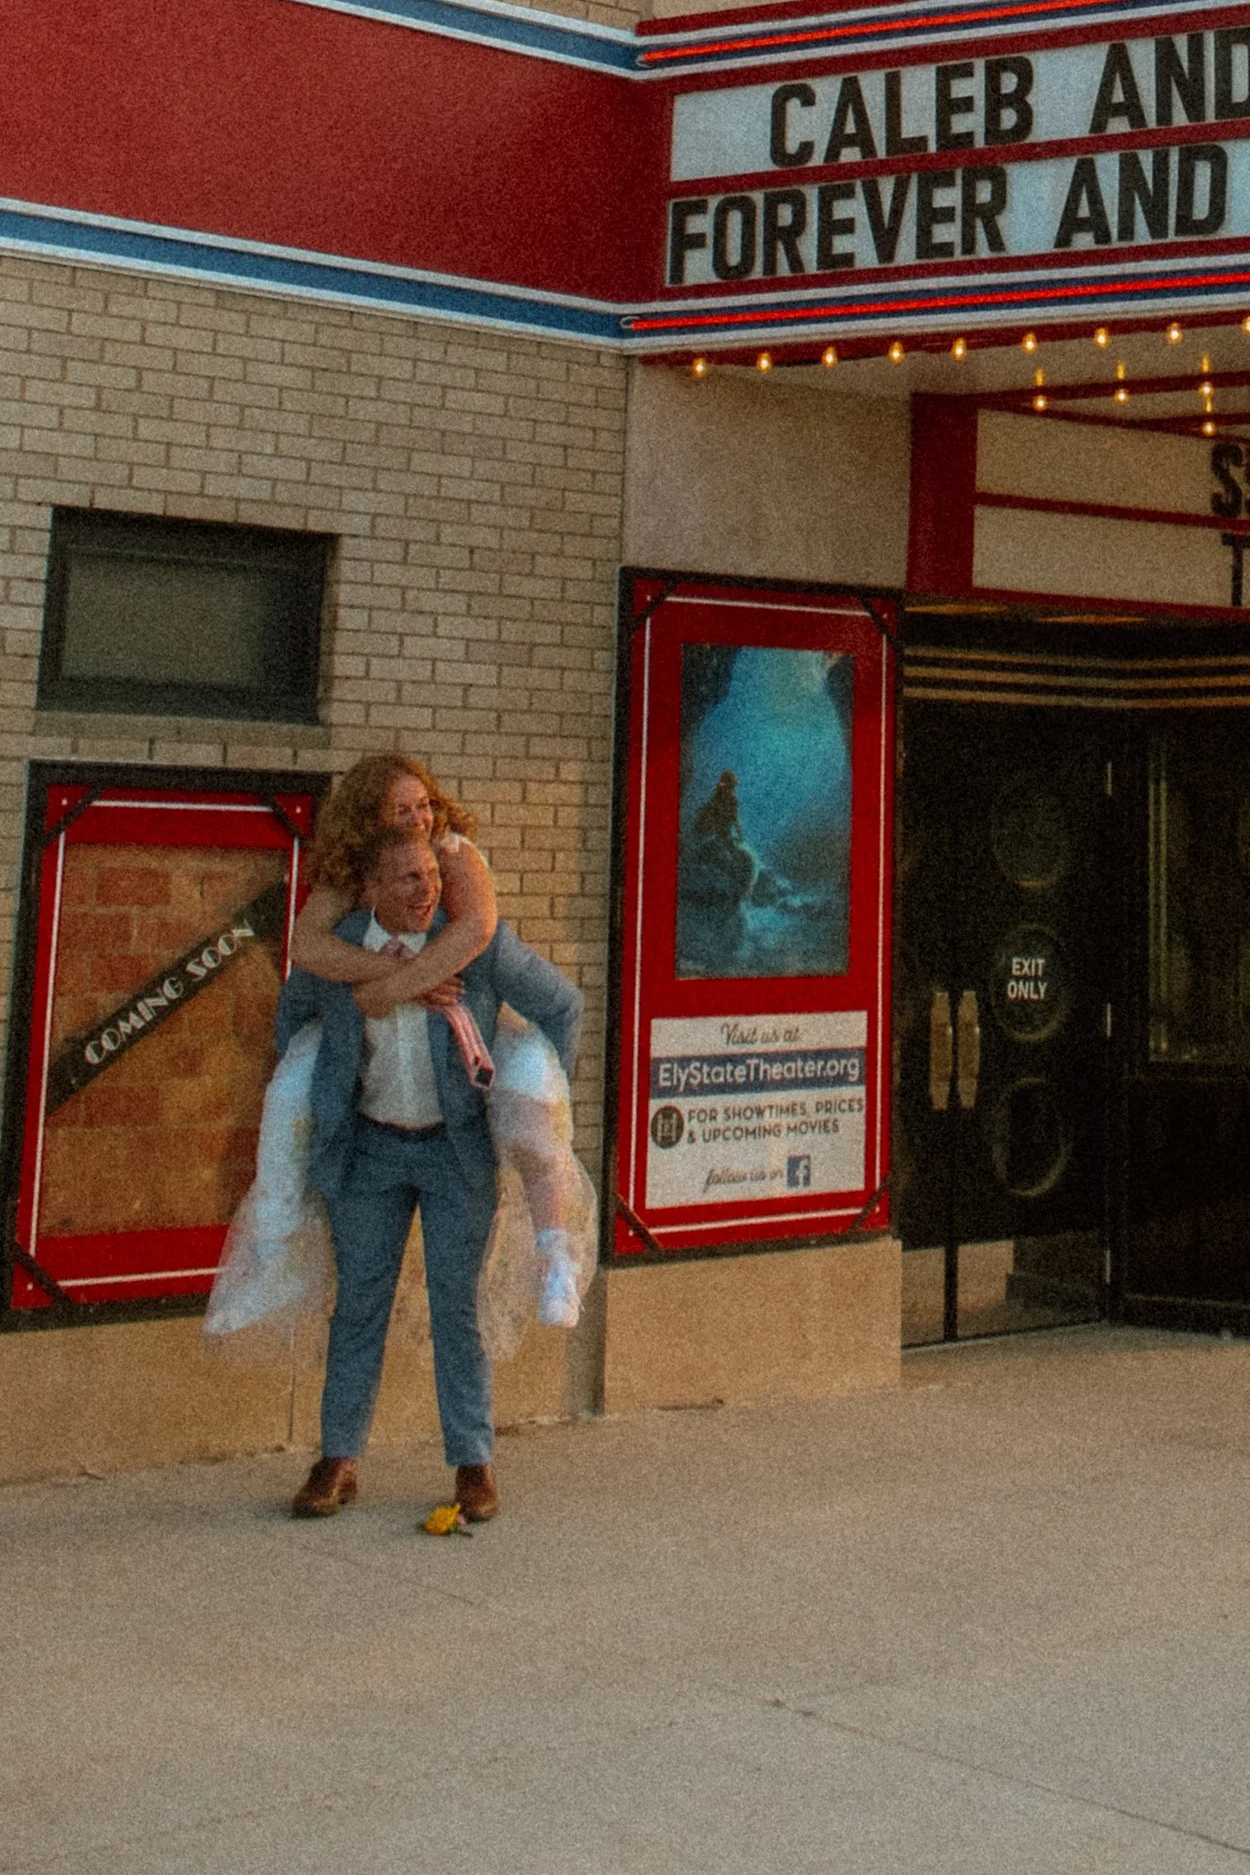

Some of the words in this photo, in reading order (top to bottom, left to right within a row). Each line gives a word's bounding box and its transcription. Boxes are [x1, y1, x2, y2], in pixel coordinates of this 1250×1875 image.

[769, 55, 1035, 169] CALEB
[668, 164, 1009, 286] FOREVER
[1053, 143, 1228, 249] AND
[1012, 957, 1045, 977] EXIT
[84, 977, 184, 1064] COMING
[186, 920, 254, 982] SOON
[1008, 980, 1048, 1000] ONLY
[721, 1023, 759, 1045] Visit
[761, 1028, 780, 1042] us
[783, 1027, 801, 1042] at
[658, 1057, 860, 1092] ElyStateTheater.org
[687, 1107, 717, 1123] FOR
[815, 1099, 863, 1115] PRICES
[687, 1130, 696, 1144] &
[702, 1124, 781, 1143] UPCOMING
[786, 1119, 839, 1136] MOVIES
